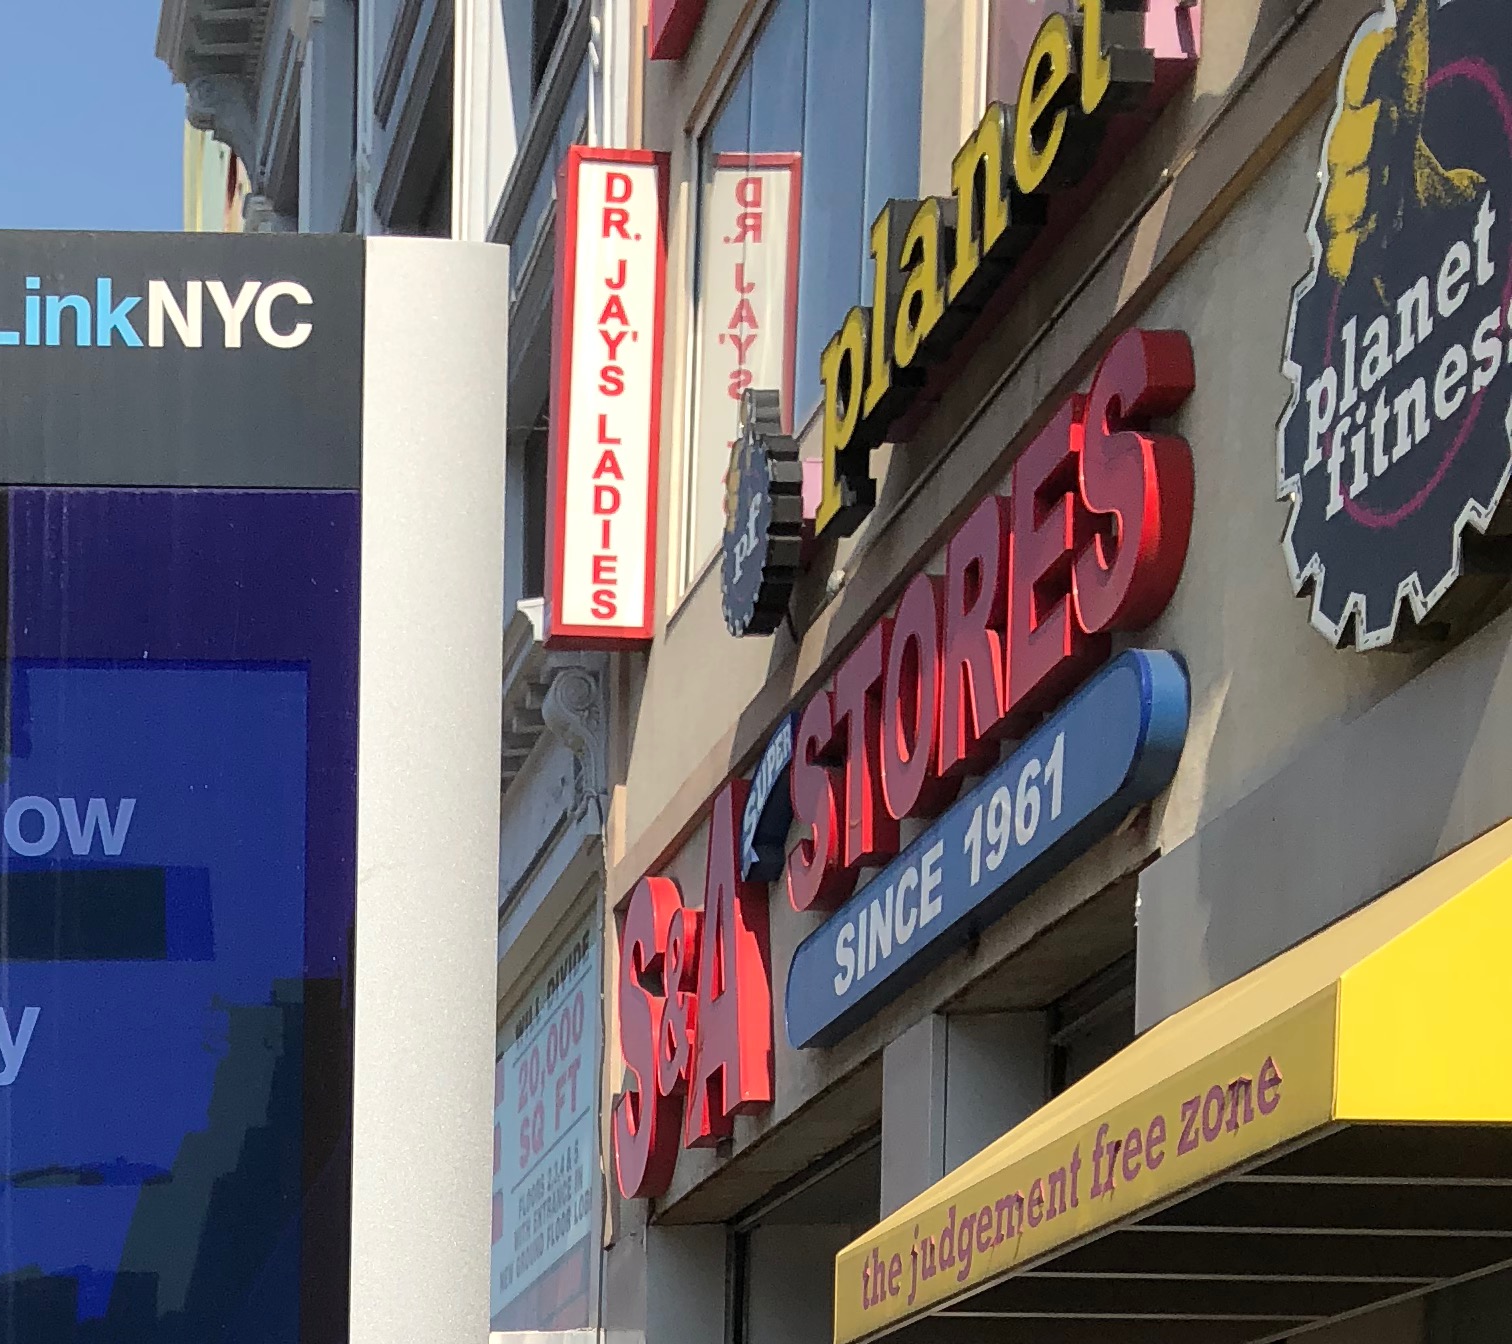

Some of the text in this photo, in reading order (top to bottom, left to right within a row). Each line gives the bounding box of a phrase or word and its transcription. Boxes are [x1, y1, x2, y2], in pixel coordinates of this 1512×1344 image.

[591, 172, 641, 620] DR. JAY'S LADIES
[815, 0, 1110, 537] planet
[1303, 191, 1496, 475] planet
[1326, 296, 1512, 521] fitnes
[614, 779, 771, 1199] S&A
[789, 329, 1193, 911] STORES
[834, 731, 1065, 996] SINCE 1961
[518, 991, 584, 1113] 20,000
[519, 1053, 581, 1168] SQ FT
[862, 1056, 1283, 1310] the judgement free zone
